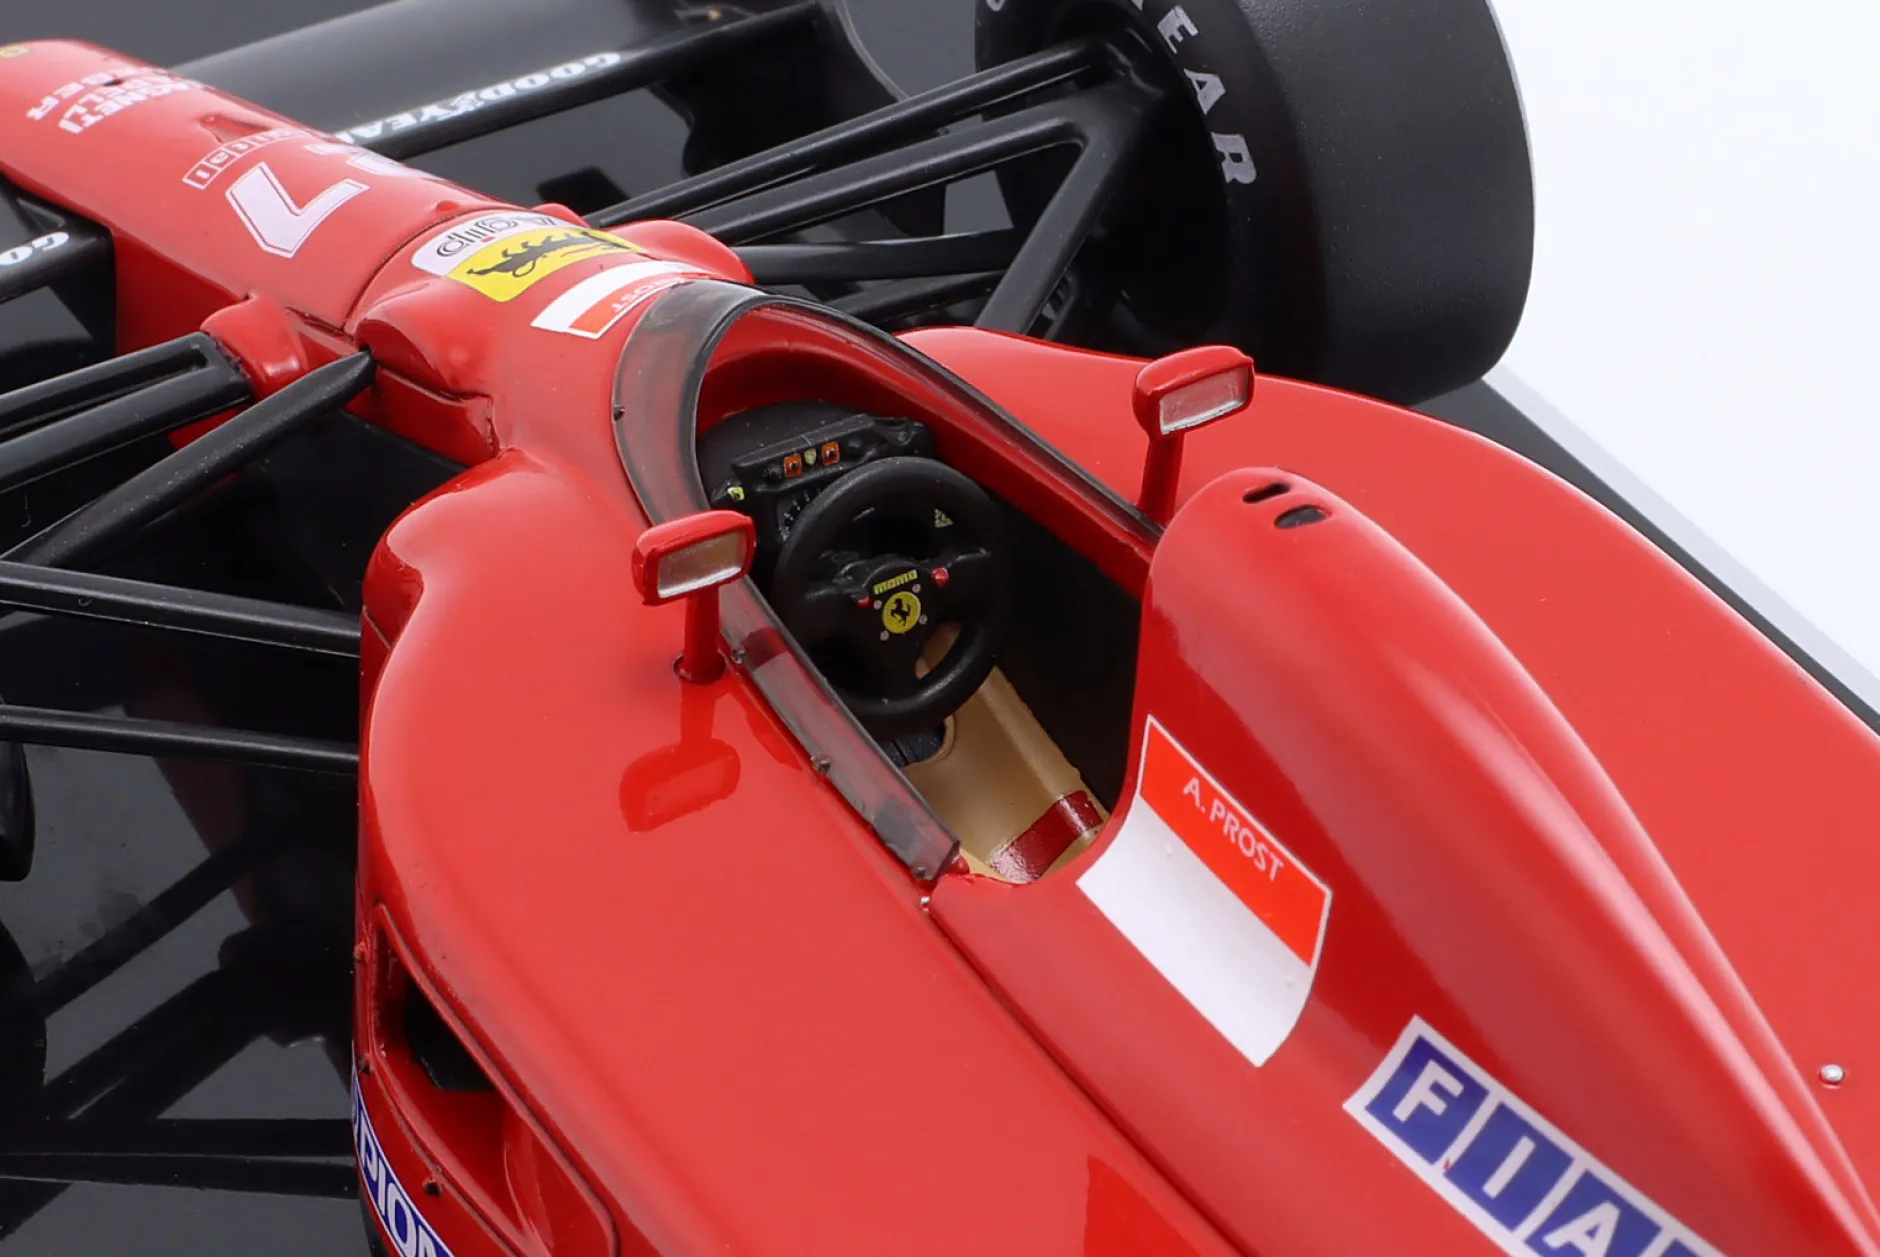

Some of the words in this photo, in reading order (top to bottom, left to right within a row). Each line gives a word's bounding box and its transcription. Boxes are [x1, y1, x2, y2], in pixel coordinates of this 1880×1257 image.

[1129, 0, 1257, 184] EAR
[1183, 777, 1206, 814] A.
[1209, 797, 1285, 882] PROST
